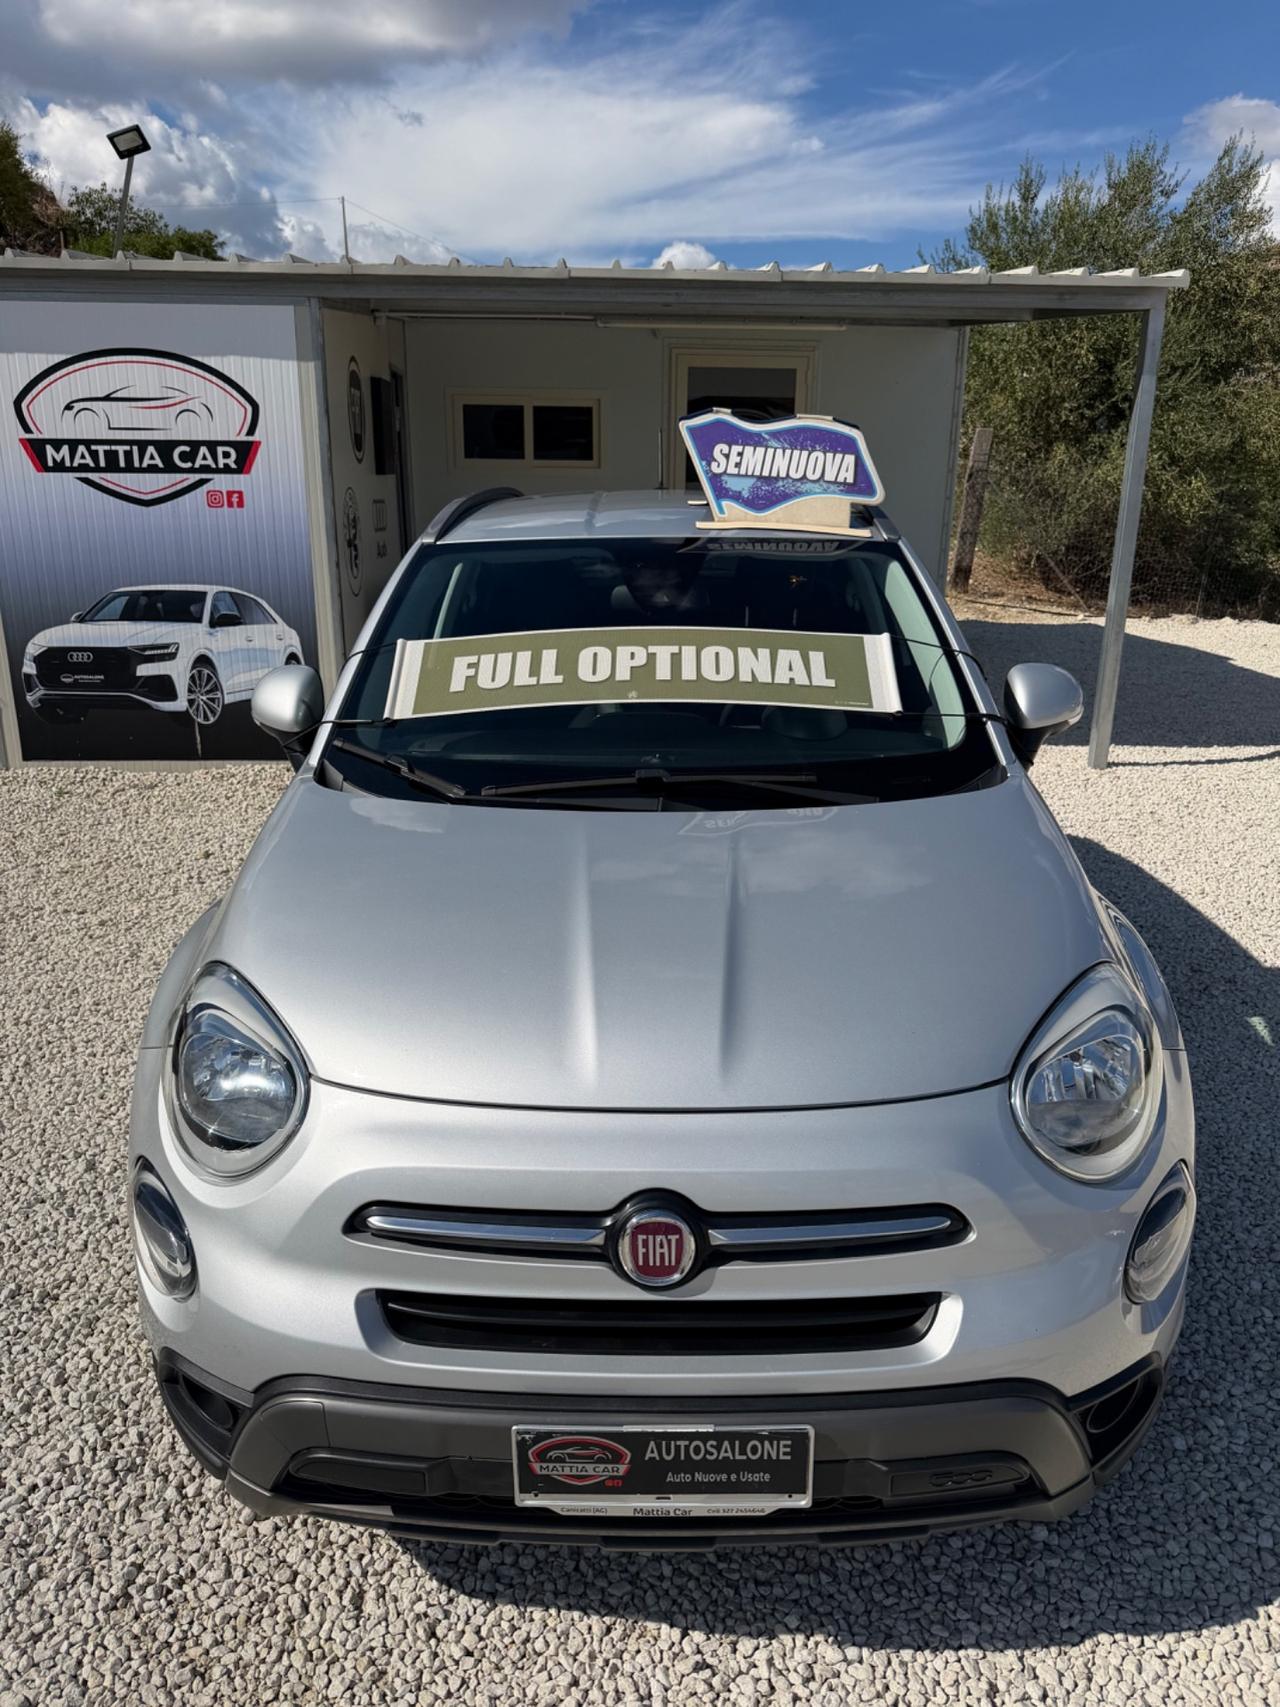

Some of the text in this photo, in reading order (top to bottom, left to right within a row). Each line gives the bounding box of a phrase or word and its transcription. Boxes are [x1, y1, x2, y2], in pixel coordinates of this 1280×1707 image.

[44, 443, 238, 470] MATTIA CAR
[710, 442, 857, 484] SEMINUOVA
[448, 645, 836, 693] FULL OPTIONAL
[637, 1234, 680, 1266] FIAT
[644, 1439, 793, 1461] AUTOSALONE
[539, 1464, 620, 1474] MATTIA CAR
[666, 1472, 692, 1482] Auto
[694, 1472, 728, 1482] Nuove
[739, 1471, 771, 1482] Usate
[633, 1508, 693, 1516] Mattia Car
